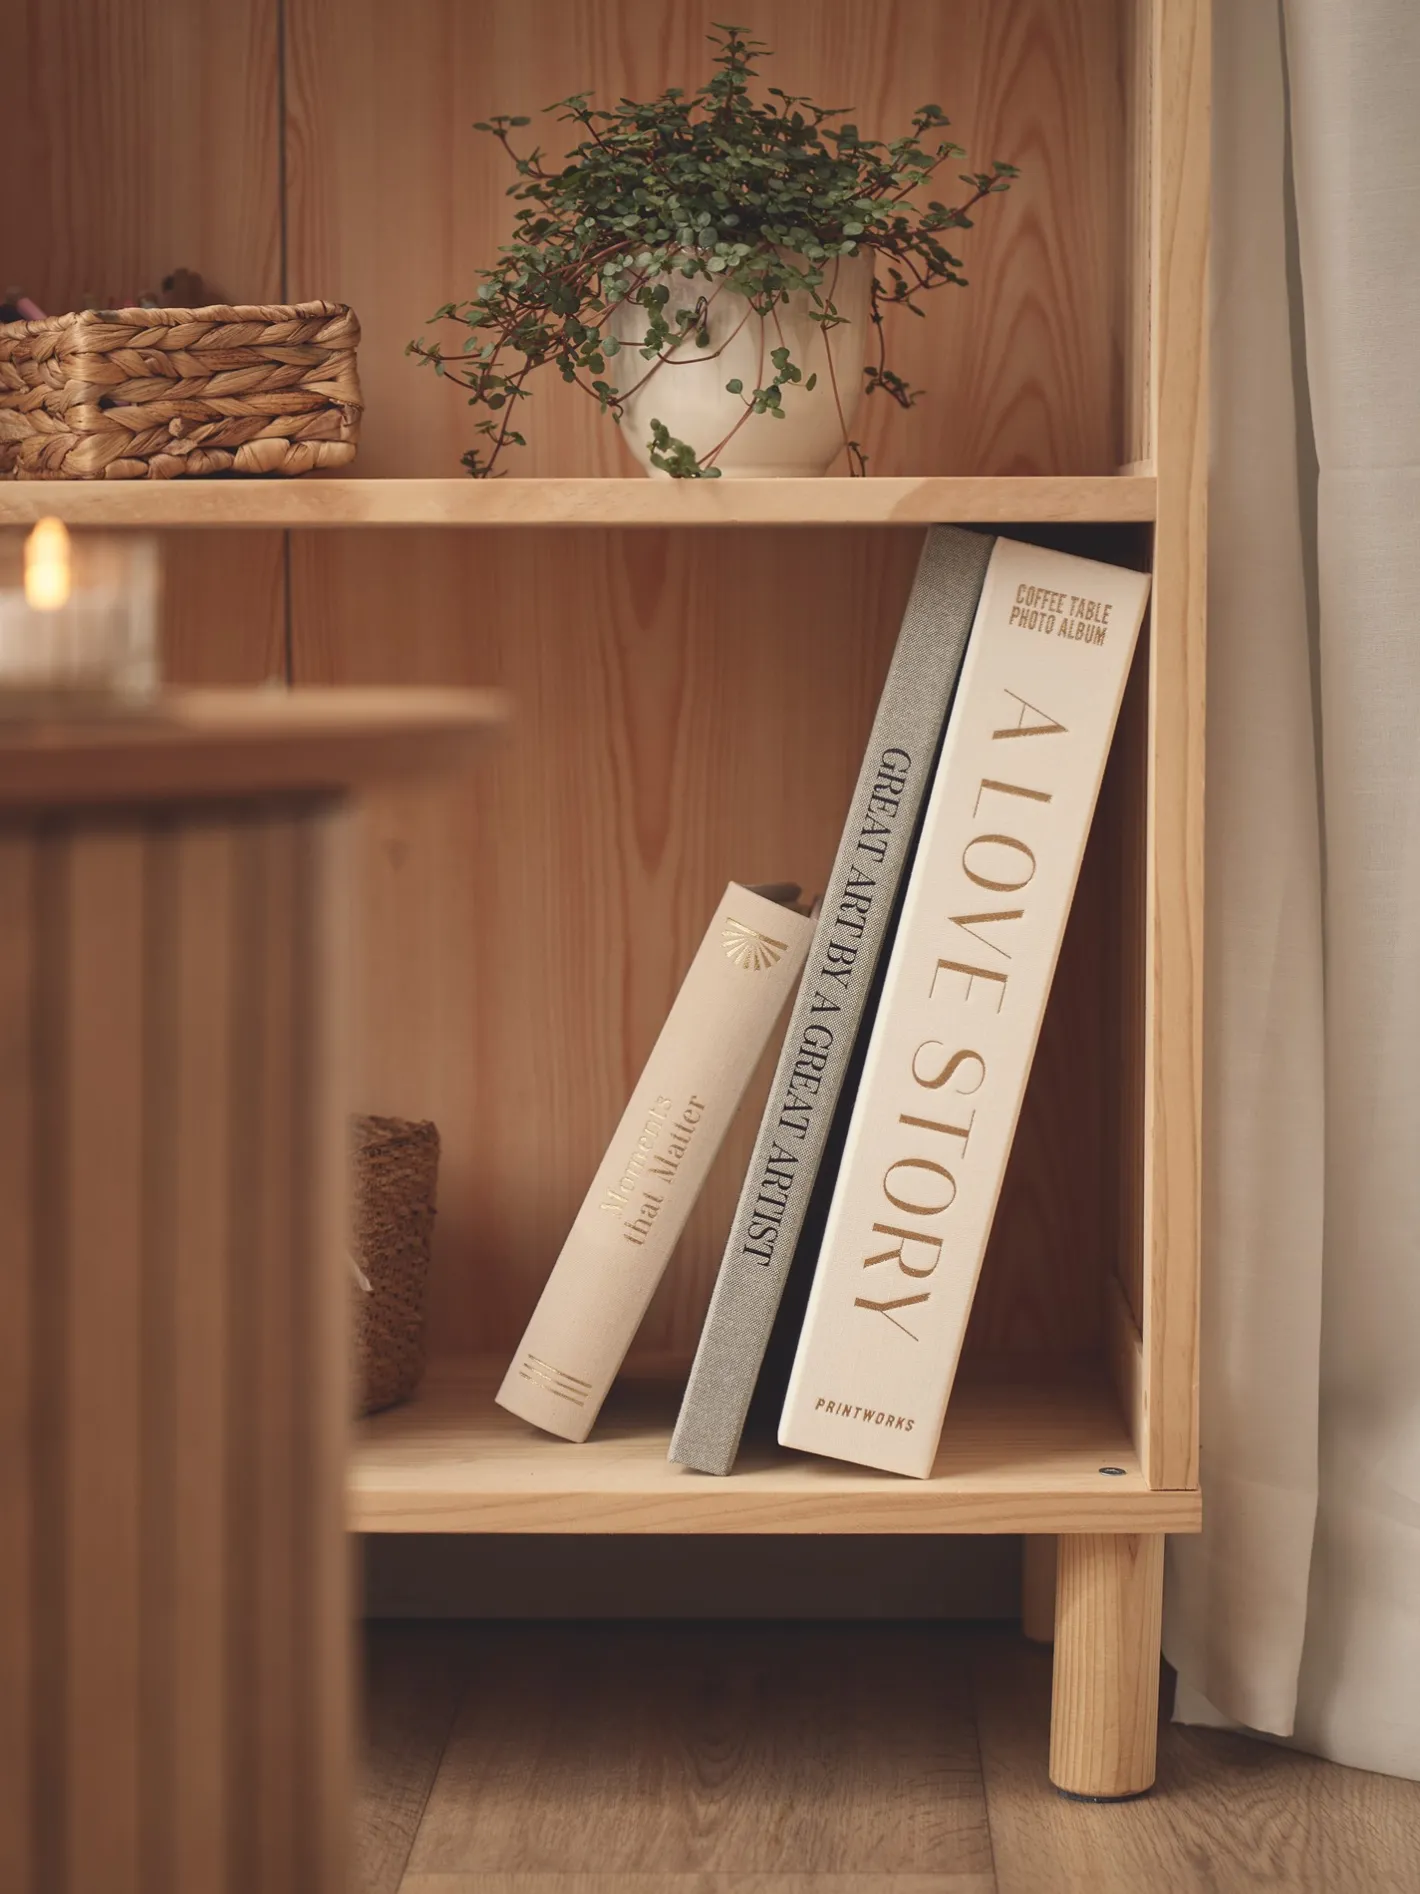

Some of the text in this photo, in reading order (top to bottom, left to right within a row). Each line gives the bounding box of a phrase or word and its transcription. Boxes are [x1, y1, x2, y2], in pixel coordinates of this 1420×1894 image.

[1009, 605, 1108, 647] PHOTO ALBUM
[1015, 584, 1113, 625] COFFEE TABLE
[742, 747, 912, 1268] GREAT ART BY A GREAT ARTIST
[854, 689, 1069, 1342] A LOVE STORY
[600, 1095, 673, 1219] Moments
[623, 1095, 706, 1246] that Matter
[815, 1398, 916, 1432] PRINTWORKS
